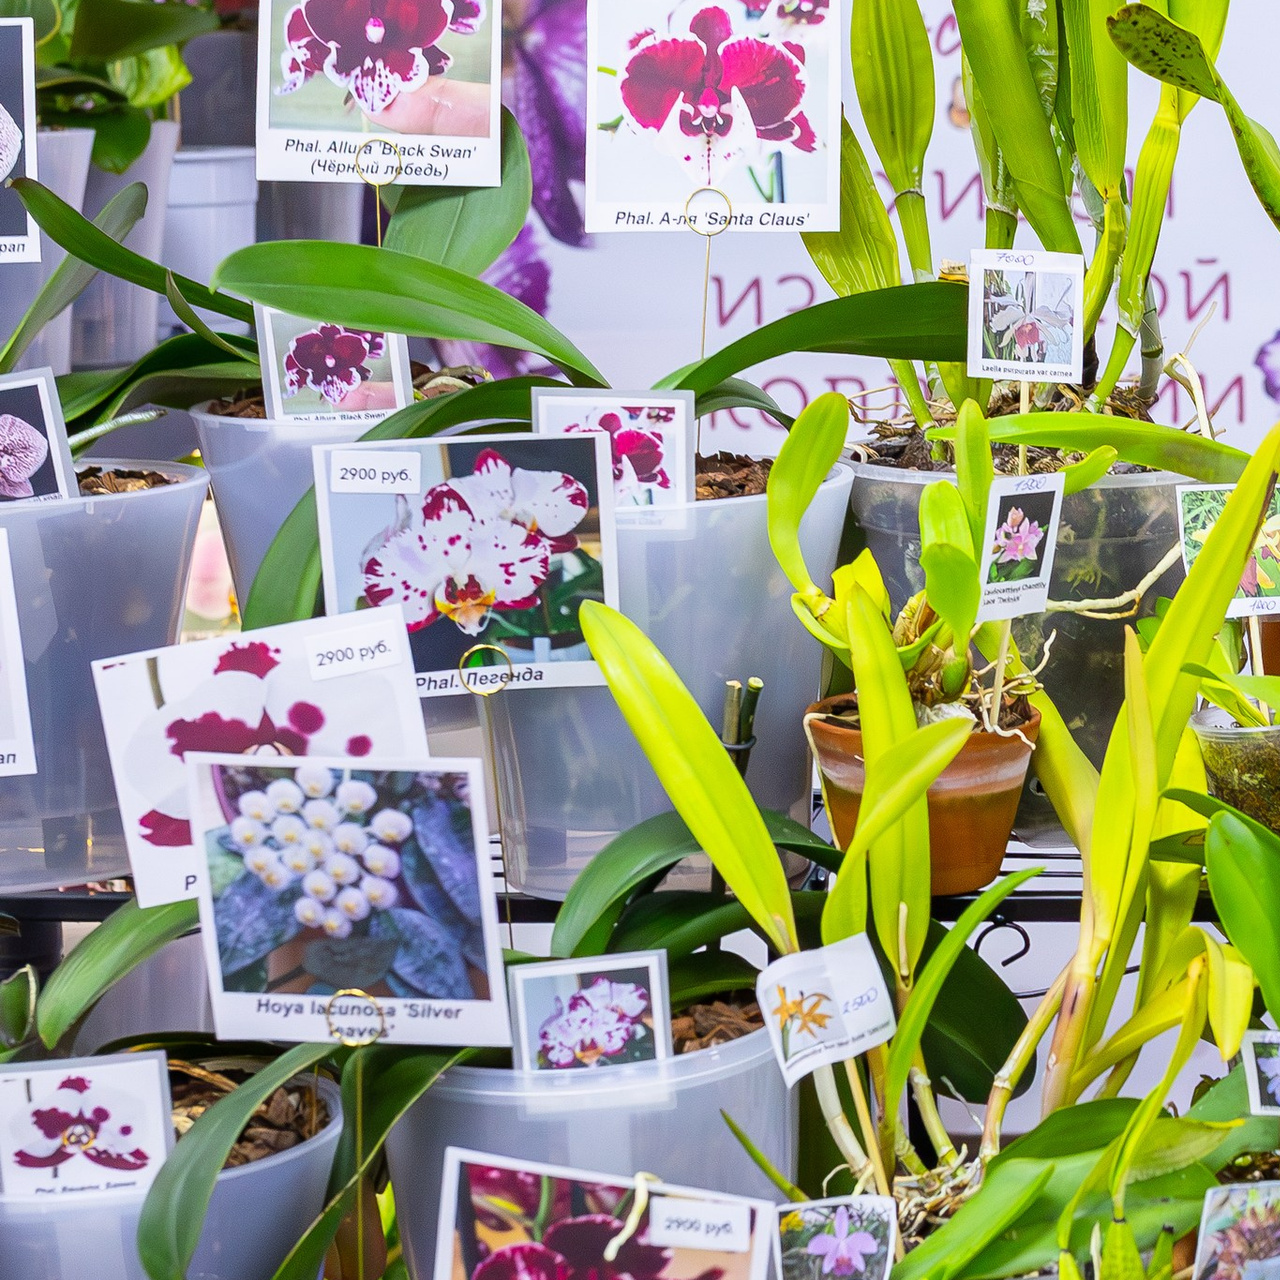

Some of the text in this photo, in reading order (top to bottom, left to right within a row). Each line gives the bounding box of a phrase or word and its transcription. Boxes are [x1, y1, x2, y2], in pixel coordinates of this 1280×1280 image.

[285, 138, 322, 153] Phal.
[379, 142, 424, 157] 'Black
[430, 144, 477, 159] Swan'
[384, 161, 449, 179] лебедь)
[615, 211, 654, 225] Phal.
[704, 211, 753, 226] 'Santa
[760, 212, 810, 226] Claus'
[996, 252, 1035, 265] 7000
[340, 467, 412, 483] 2900 руб.
[316, 641, 391, 667] 2900 руб.
[416, 674, 459, 691] Phal.
[256, 999, 463, 1019] Hoya lacunosa 'Silver
